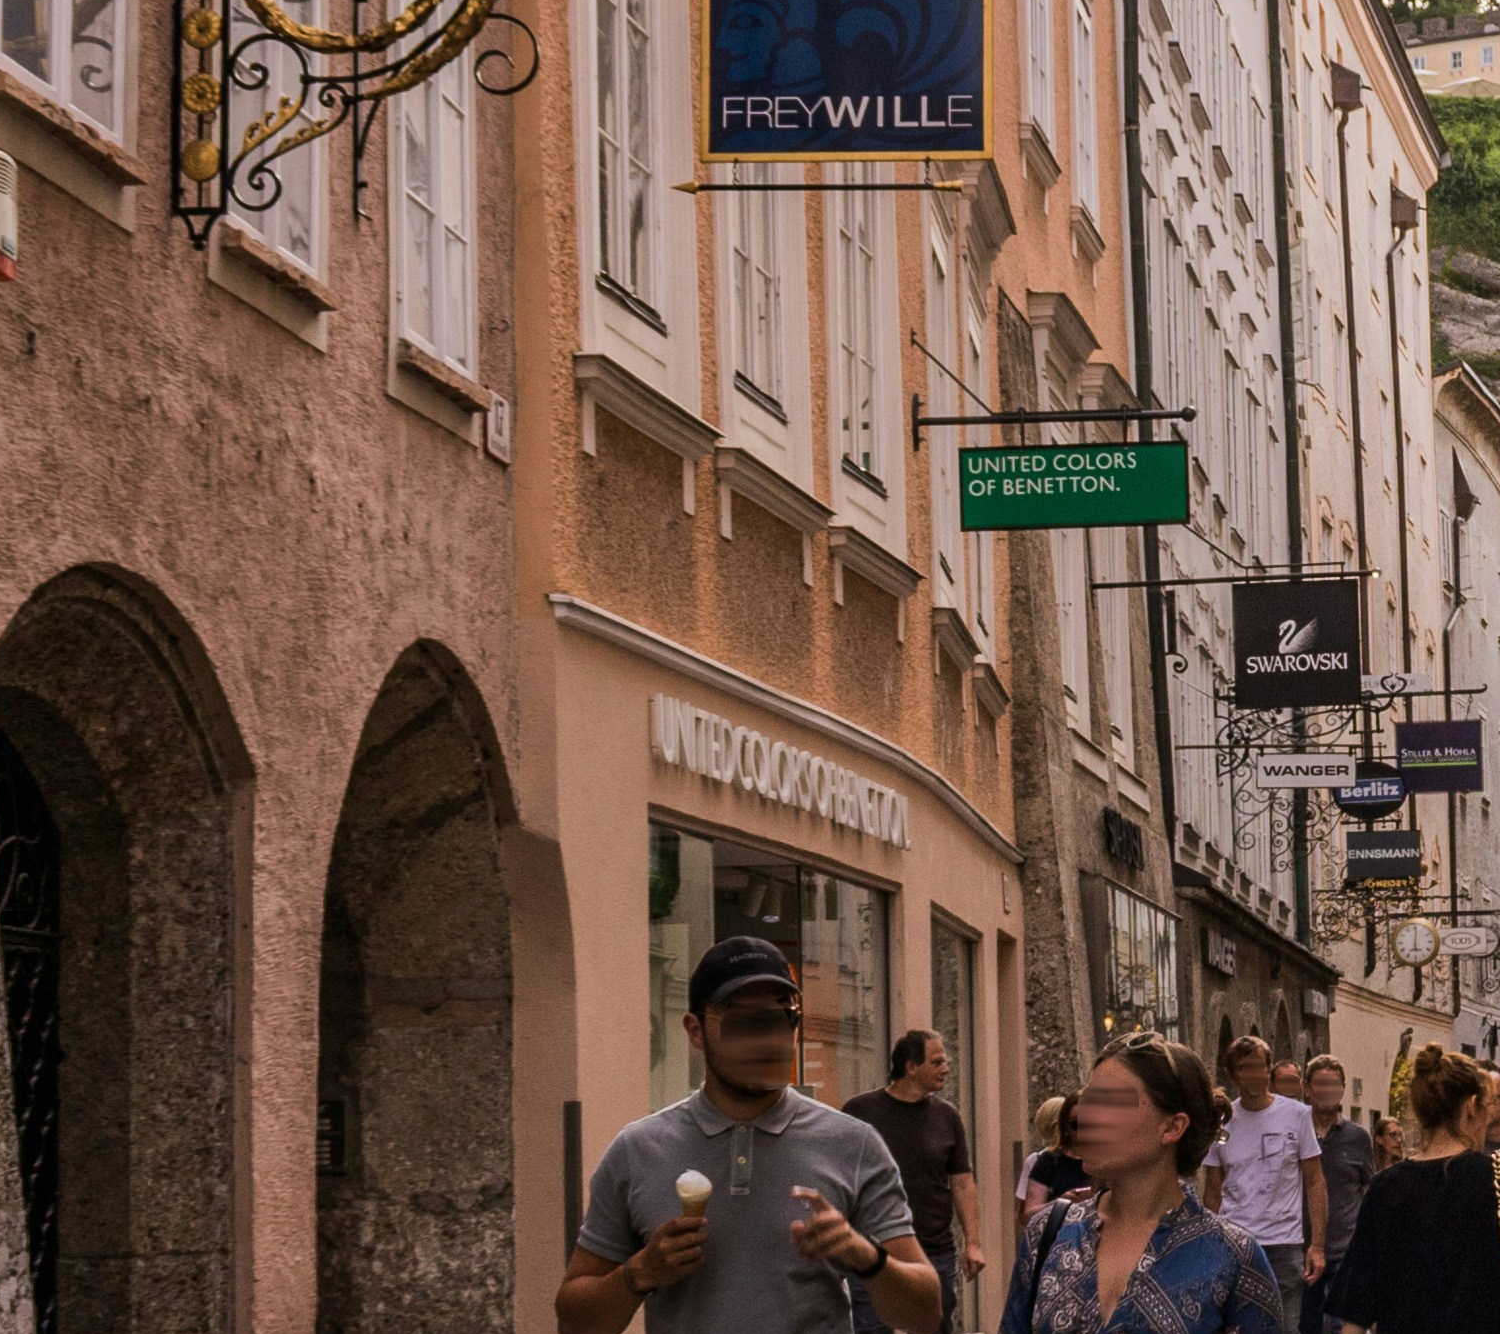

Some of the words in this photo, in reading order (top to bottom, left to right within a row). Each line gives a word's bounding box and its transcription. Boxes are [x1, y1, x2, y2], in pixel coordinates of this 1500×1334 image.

[722, 95, 974, 129] FREYWILLE
[968, 455, 1047, 474] UNITED
[1053, 452, 1137, 471] COLORS
[968, 479, 996, 497] OF
[1003, 475, 1121, 496] BENETTON.
[1246, 652, 1349, 674] SWAROVSKI
[1263, 764, 1349, 777] WANGER
[1340, 781, 1400, 798] Berlitz
[1348, 848, 1420, 859] ENNSMANN
